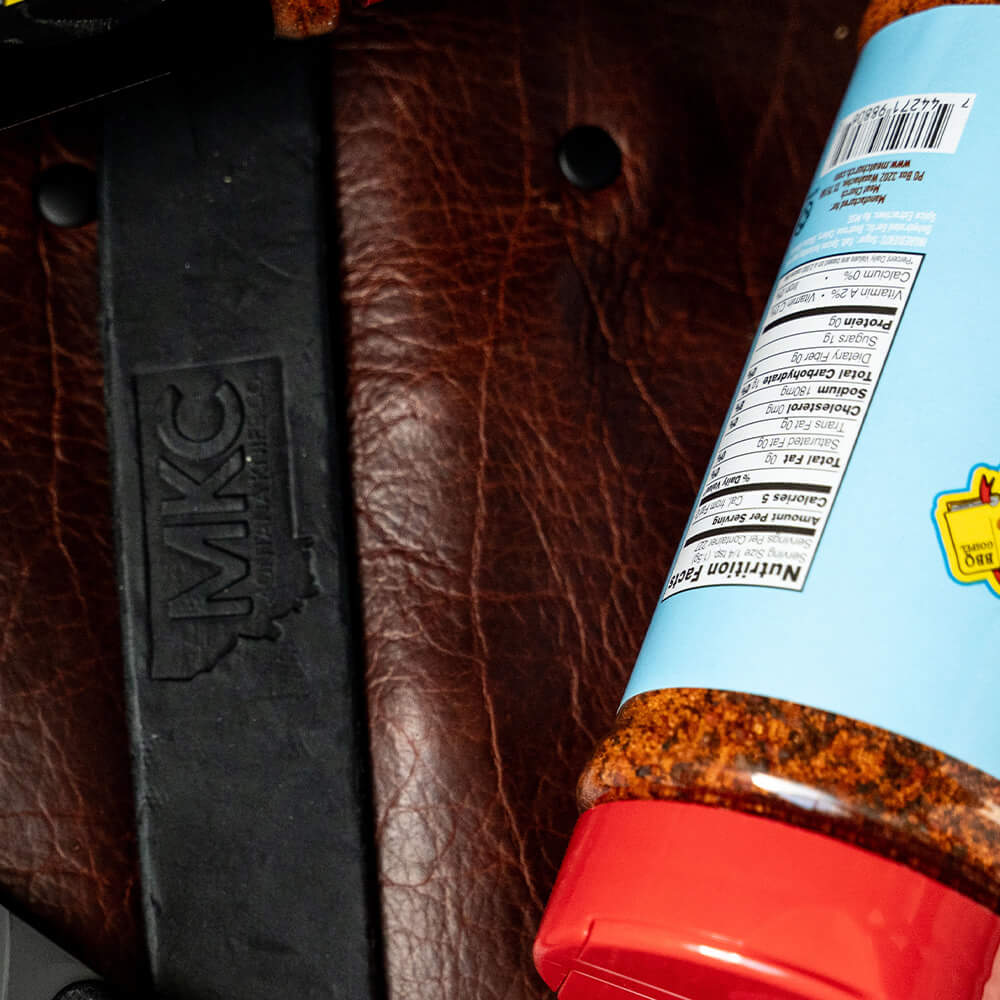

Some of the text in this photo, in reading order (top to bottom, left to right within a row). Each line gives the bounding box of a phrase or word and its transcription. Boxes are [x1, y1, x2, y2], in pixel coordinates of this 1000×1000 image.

[893, 98, 940, 113] 44271
[961, 99, 969, 108] 7
[899, 171, 913, 180] Box
[844, 270, 861, 280] 0%
[863, 270, 911, 282] Calcium
[831, 289, 848, 298] 2%
[849, 288, 859, 298] A
[861, 288, 902, 300] Vitamin
[829, 315, 892, 330] Protein 0g
[823, 333, 878, 347] Sugars 1g
[791, 352, 803, 363] 0g
[804, 351, 829, 362] Fiber
[833, 350, 871, 364] Dietary
[763, 368, 835, 386] Carbohydrate
[839, 369, 872, 381] Total
[780, 385, 812, 396] 180mg
[818, 386, 867, 399] Sodium
[765, 403, 785, 415] 0mg
[787, 403, 861, 416] Cholesterol
[781, 418, 845, 433] Trans Fat 0g
[757, 437, 768, 448] 0g
[769, 438, 785, 448] Fat
[788, 437, 840, 450] Saturated
[765, 453, 778, 464] 0g
[784, 454, 804, 465] Fat
[808, 455, 841, 468] Total
[722, 476, 741, 486] Daily
[156, 381, 251, 620] MKC
[762, 494, 769, 503] 5
[774, 494, 828, 508] Calories
[712, 513, 820, 526] Amount Per Serving
[709, 536, 746, 547] Container
[749, 536, 764, 544] Per
[768, 536, 812, 548] Servings
[748, 549, 765, 558] Size
[768, 548, 807, 562] Serving
[964, 552, 993, 568] BBQ
[668, 562, 801, 589] Nutrition Facts
